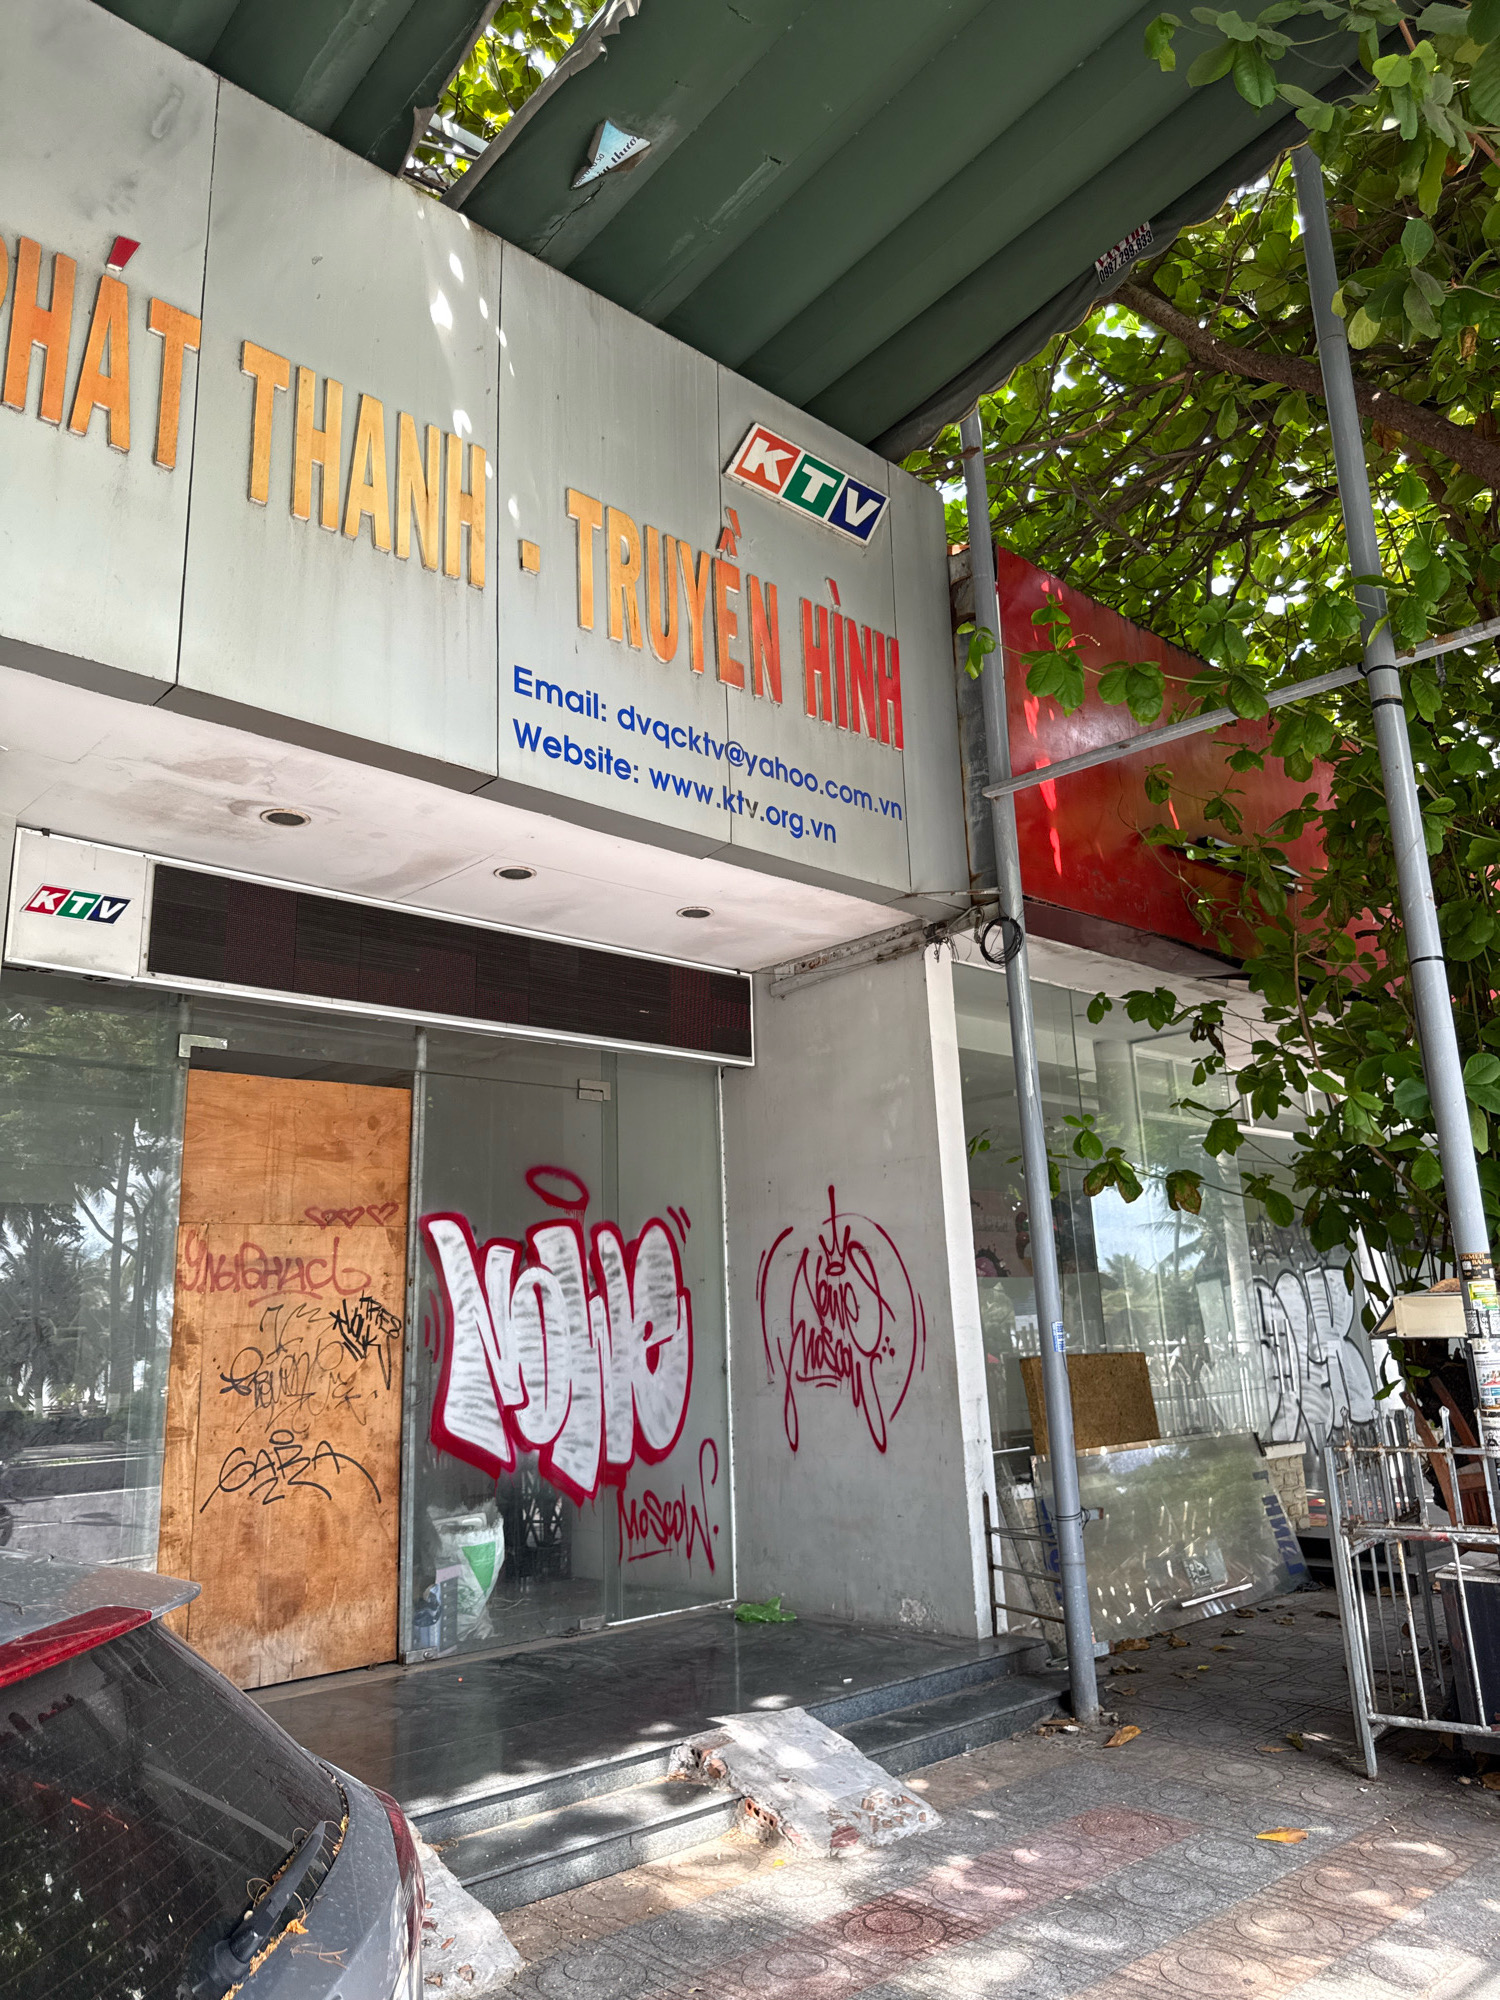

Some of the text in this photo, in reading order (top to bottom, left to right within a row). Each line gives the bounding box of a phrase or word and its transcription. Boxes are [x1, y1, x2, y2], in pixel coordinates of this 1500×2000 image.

[0, 235, 201, 471] HÁT
[242, 341, 487, 590] THANH
[566, 488, 783, 704] TRUYỀN
[800, 578, 904, 751] HÌNH
[741, 436, 881, 528] KTV
[513, 718, 836, 843] Website: www.ktv.org.vn
[514, 665, 902, 820] Email: dvqcktv@yahoo.com.vn
[29, 889, 127, 920] KTV
